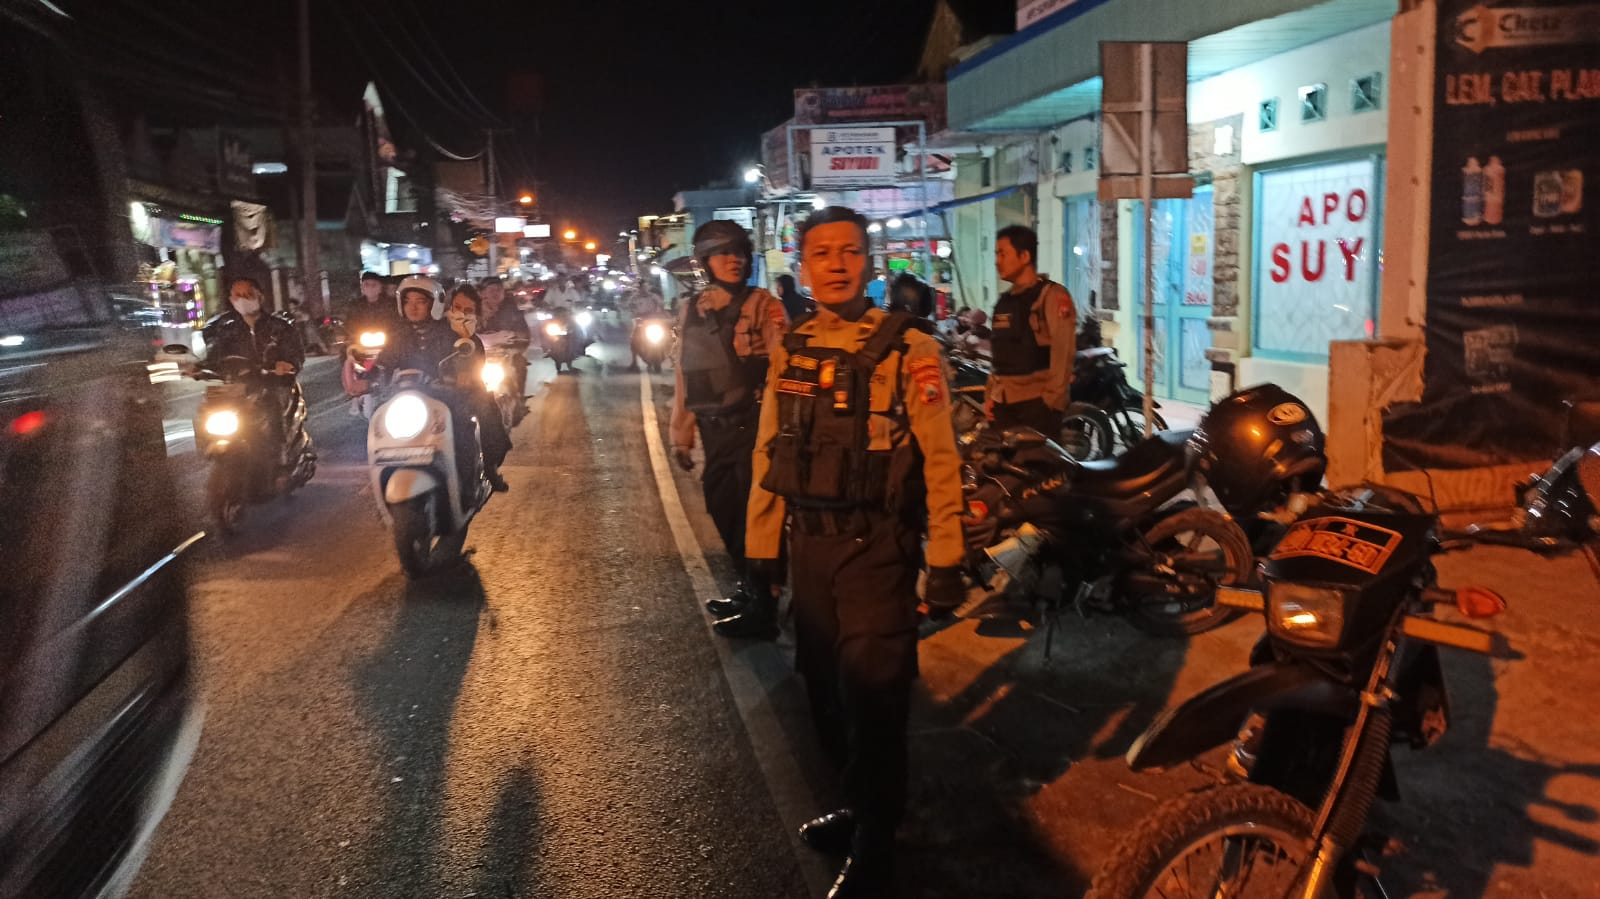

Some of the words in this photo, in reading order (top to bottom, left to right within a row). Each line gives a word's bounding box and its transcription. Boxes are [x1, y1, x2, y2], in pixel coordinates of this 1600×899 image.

[822, 145, 886, 155] APOTEK
[1297, 188, 1368, 227] APO
[1270, 236, 1363, 283] SUY
